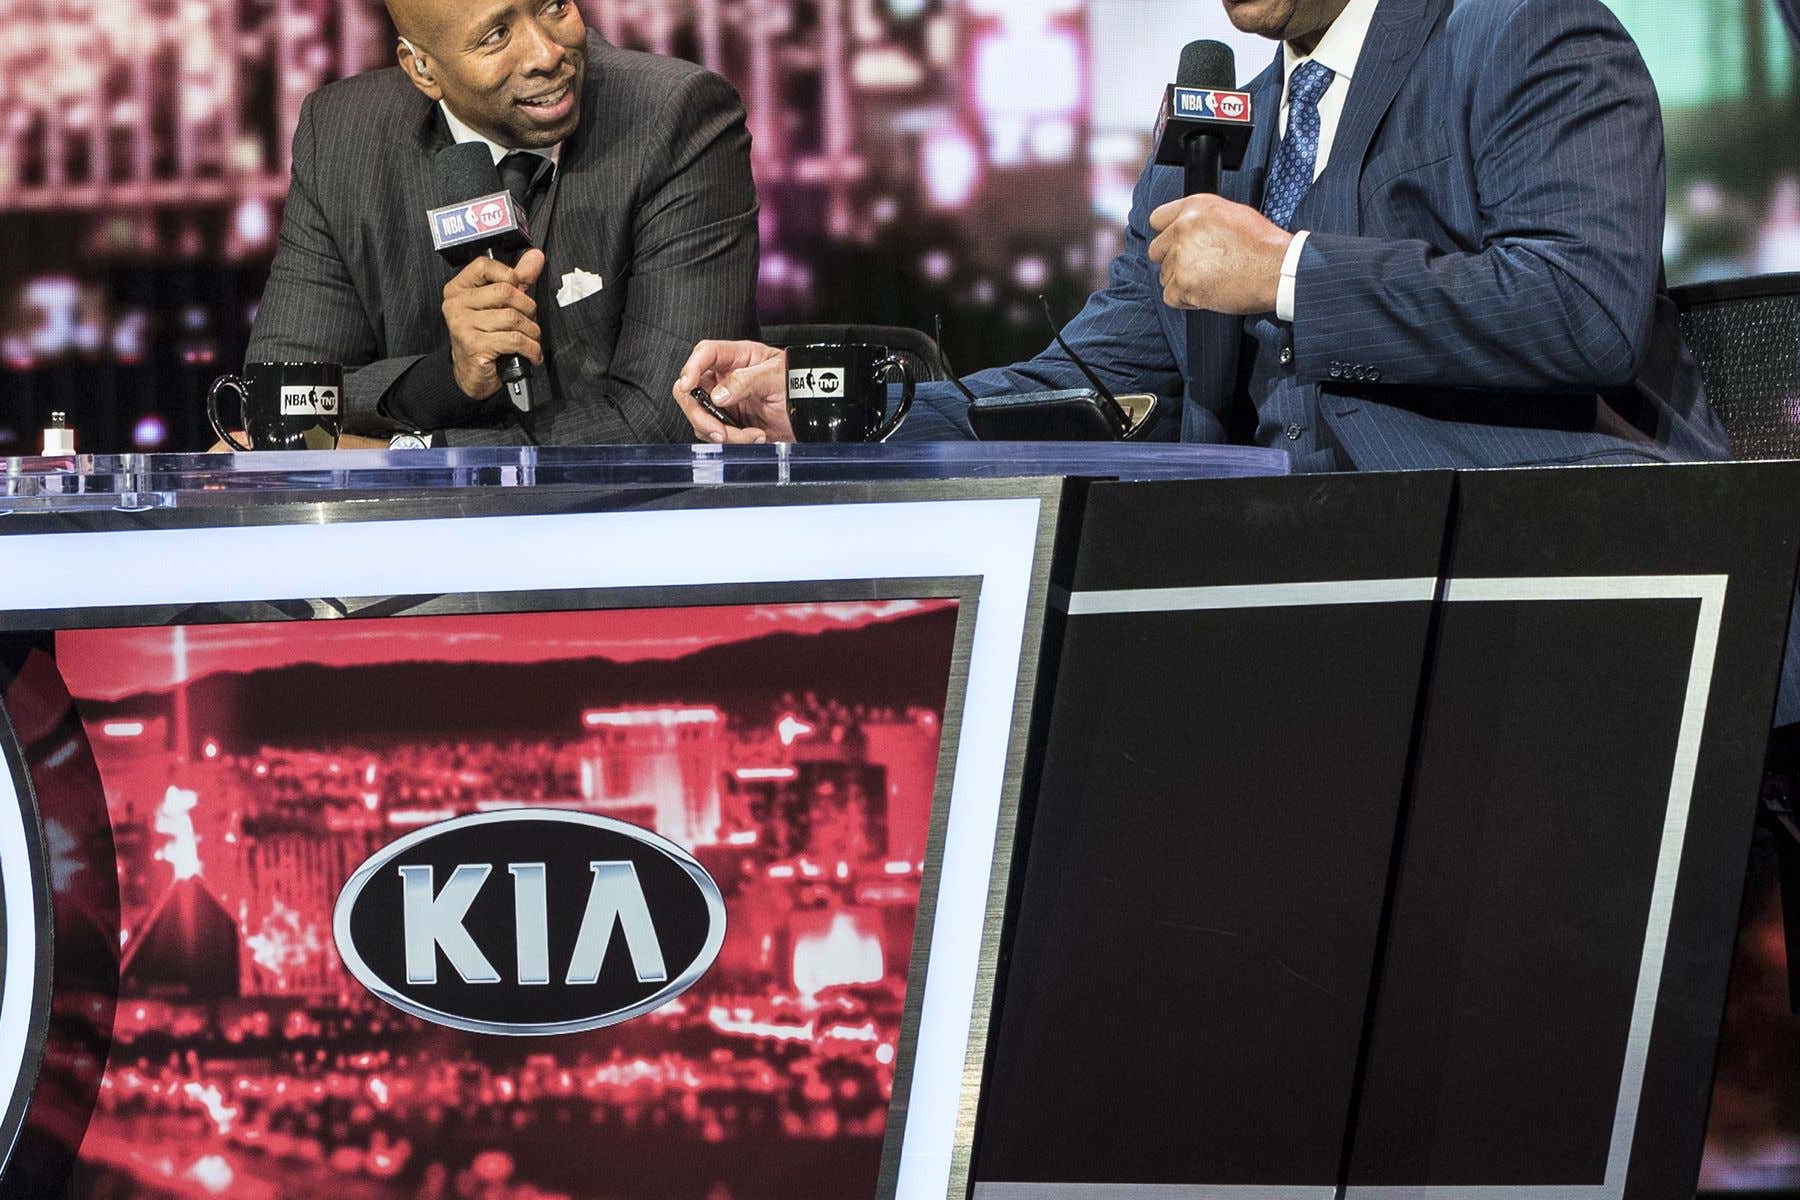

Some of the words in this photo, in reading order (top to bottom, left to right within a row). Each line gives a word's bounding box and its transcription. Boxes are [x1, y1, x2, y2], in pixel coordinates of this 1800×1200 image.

[1181, 94, 1203, 111] NBA
[1221, 101, 1244, 114] TNT
[441, 214, 465, 236] NBA
[480, 209, 502, 223] TNT
[818, 378, 840, 390] TNT
[284, 394, 307, 407] NBA
[398, 860, 668, 985] KIA
